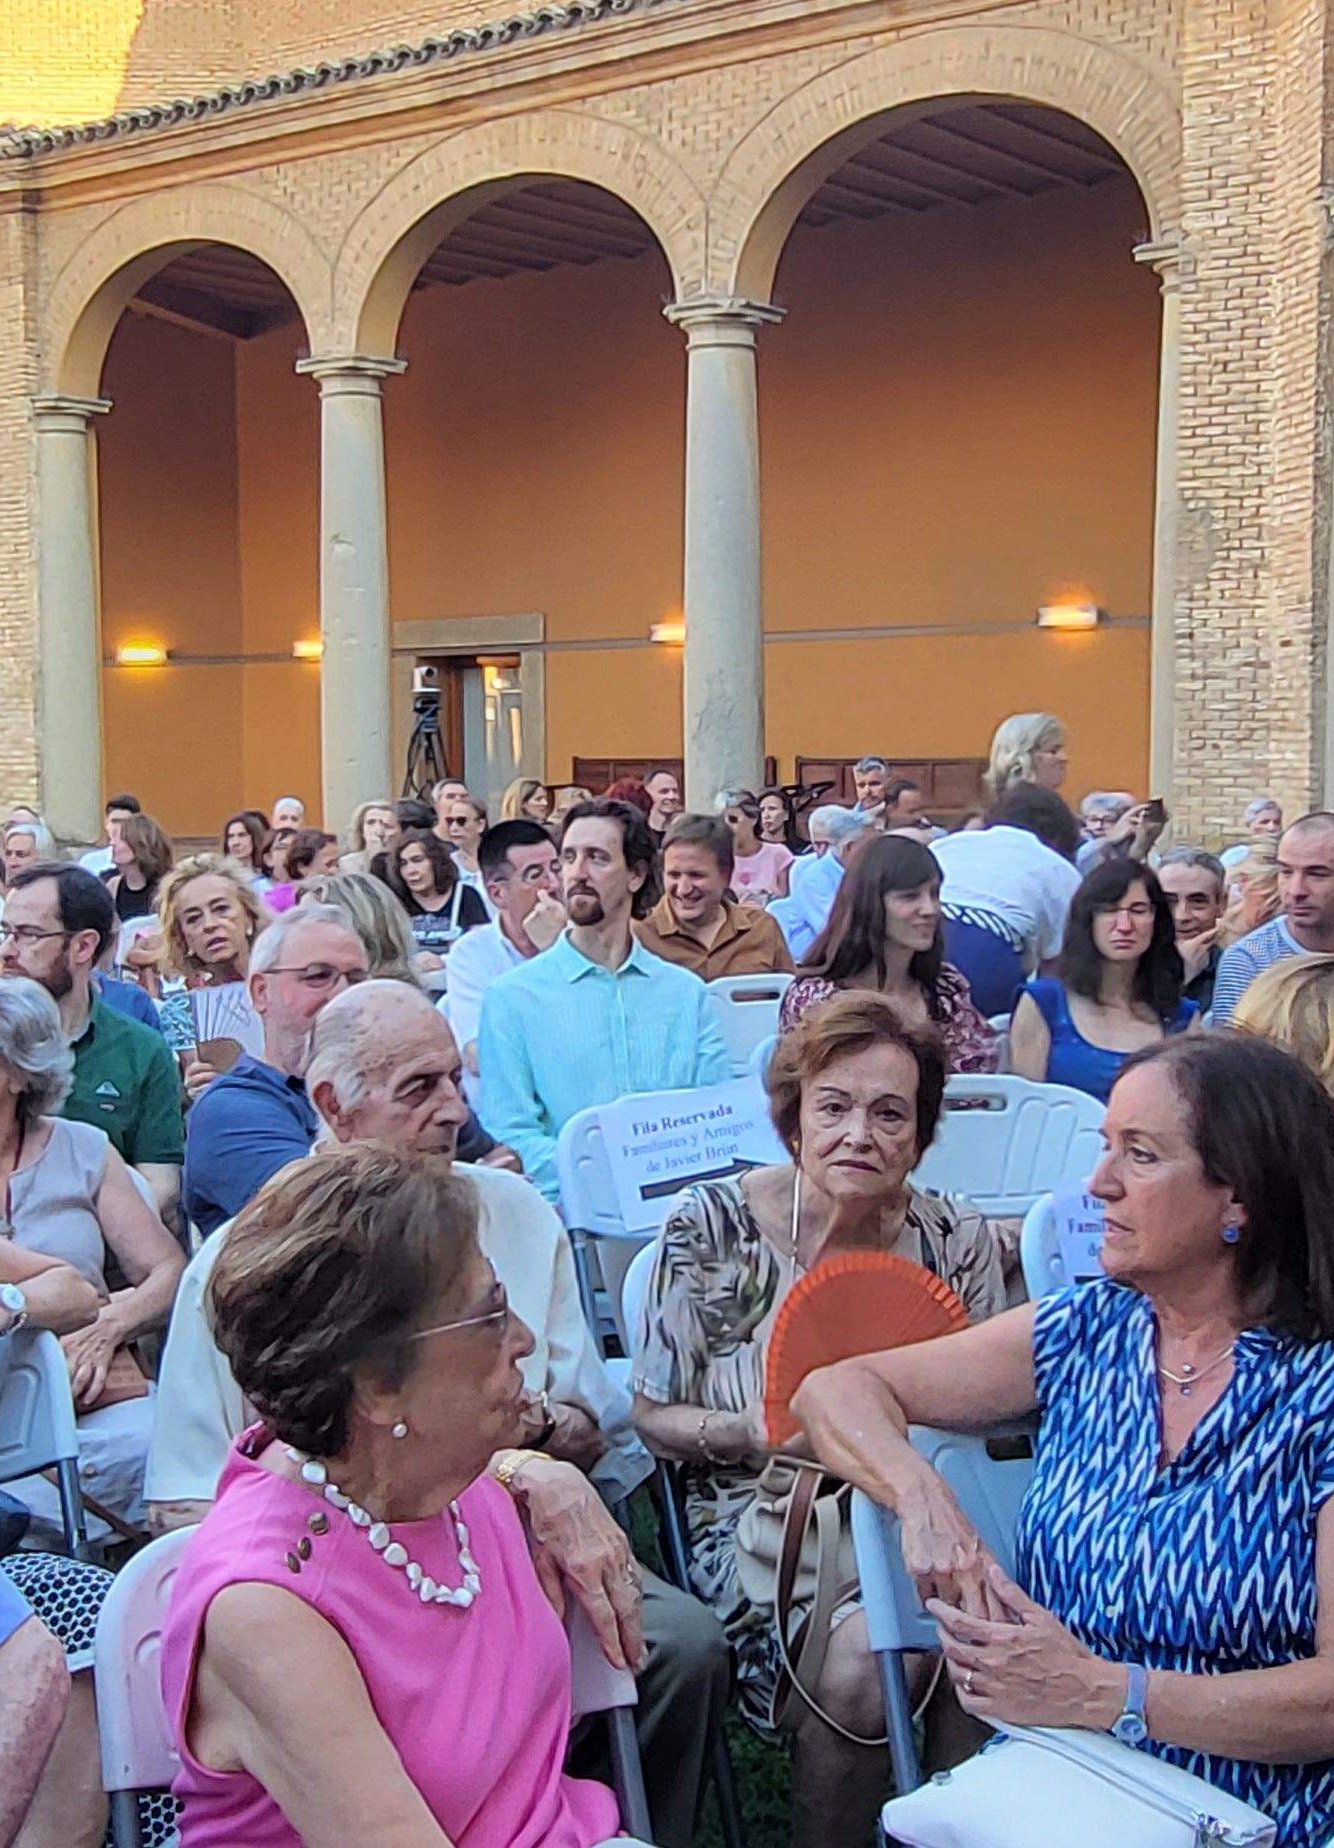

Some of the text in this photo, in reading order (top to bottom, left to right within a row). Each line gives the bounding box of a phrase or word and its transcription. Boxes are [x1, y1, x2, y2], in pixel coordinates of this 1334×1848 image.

[632, 1104, 733, 1136] Fila Reservada
[690, 1133, 699, 1147] y
[704, 1120, 754, 1140] Amigos
[646, 1159, 661, 1174] de
[665, 1151, 703, 1170] Javier
